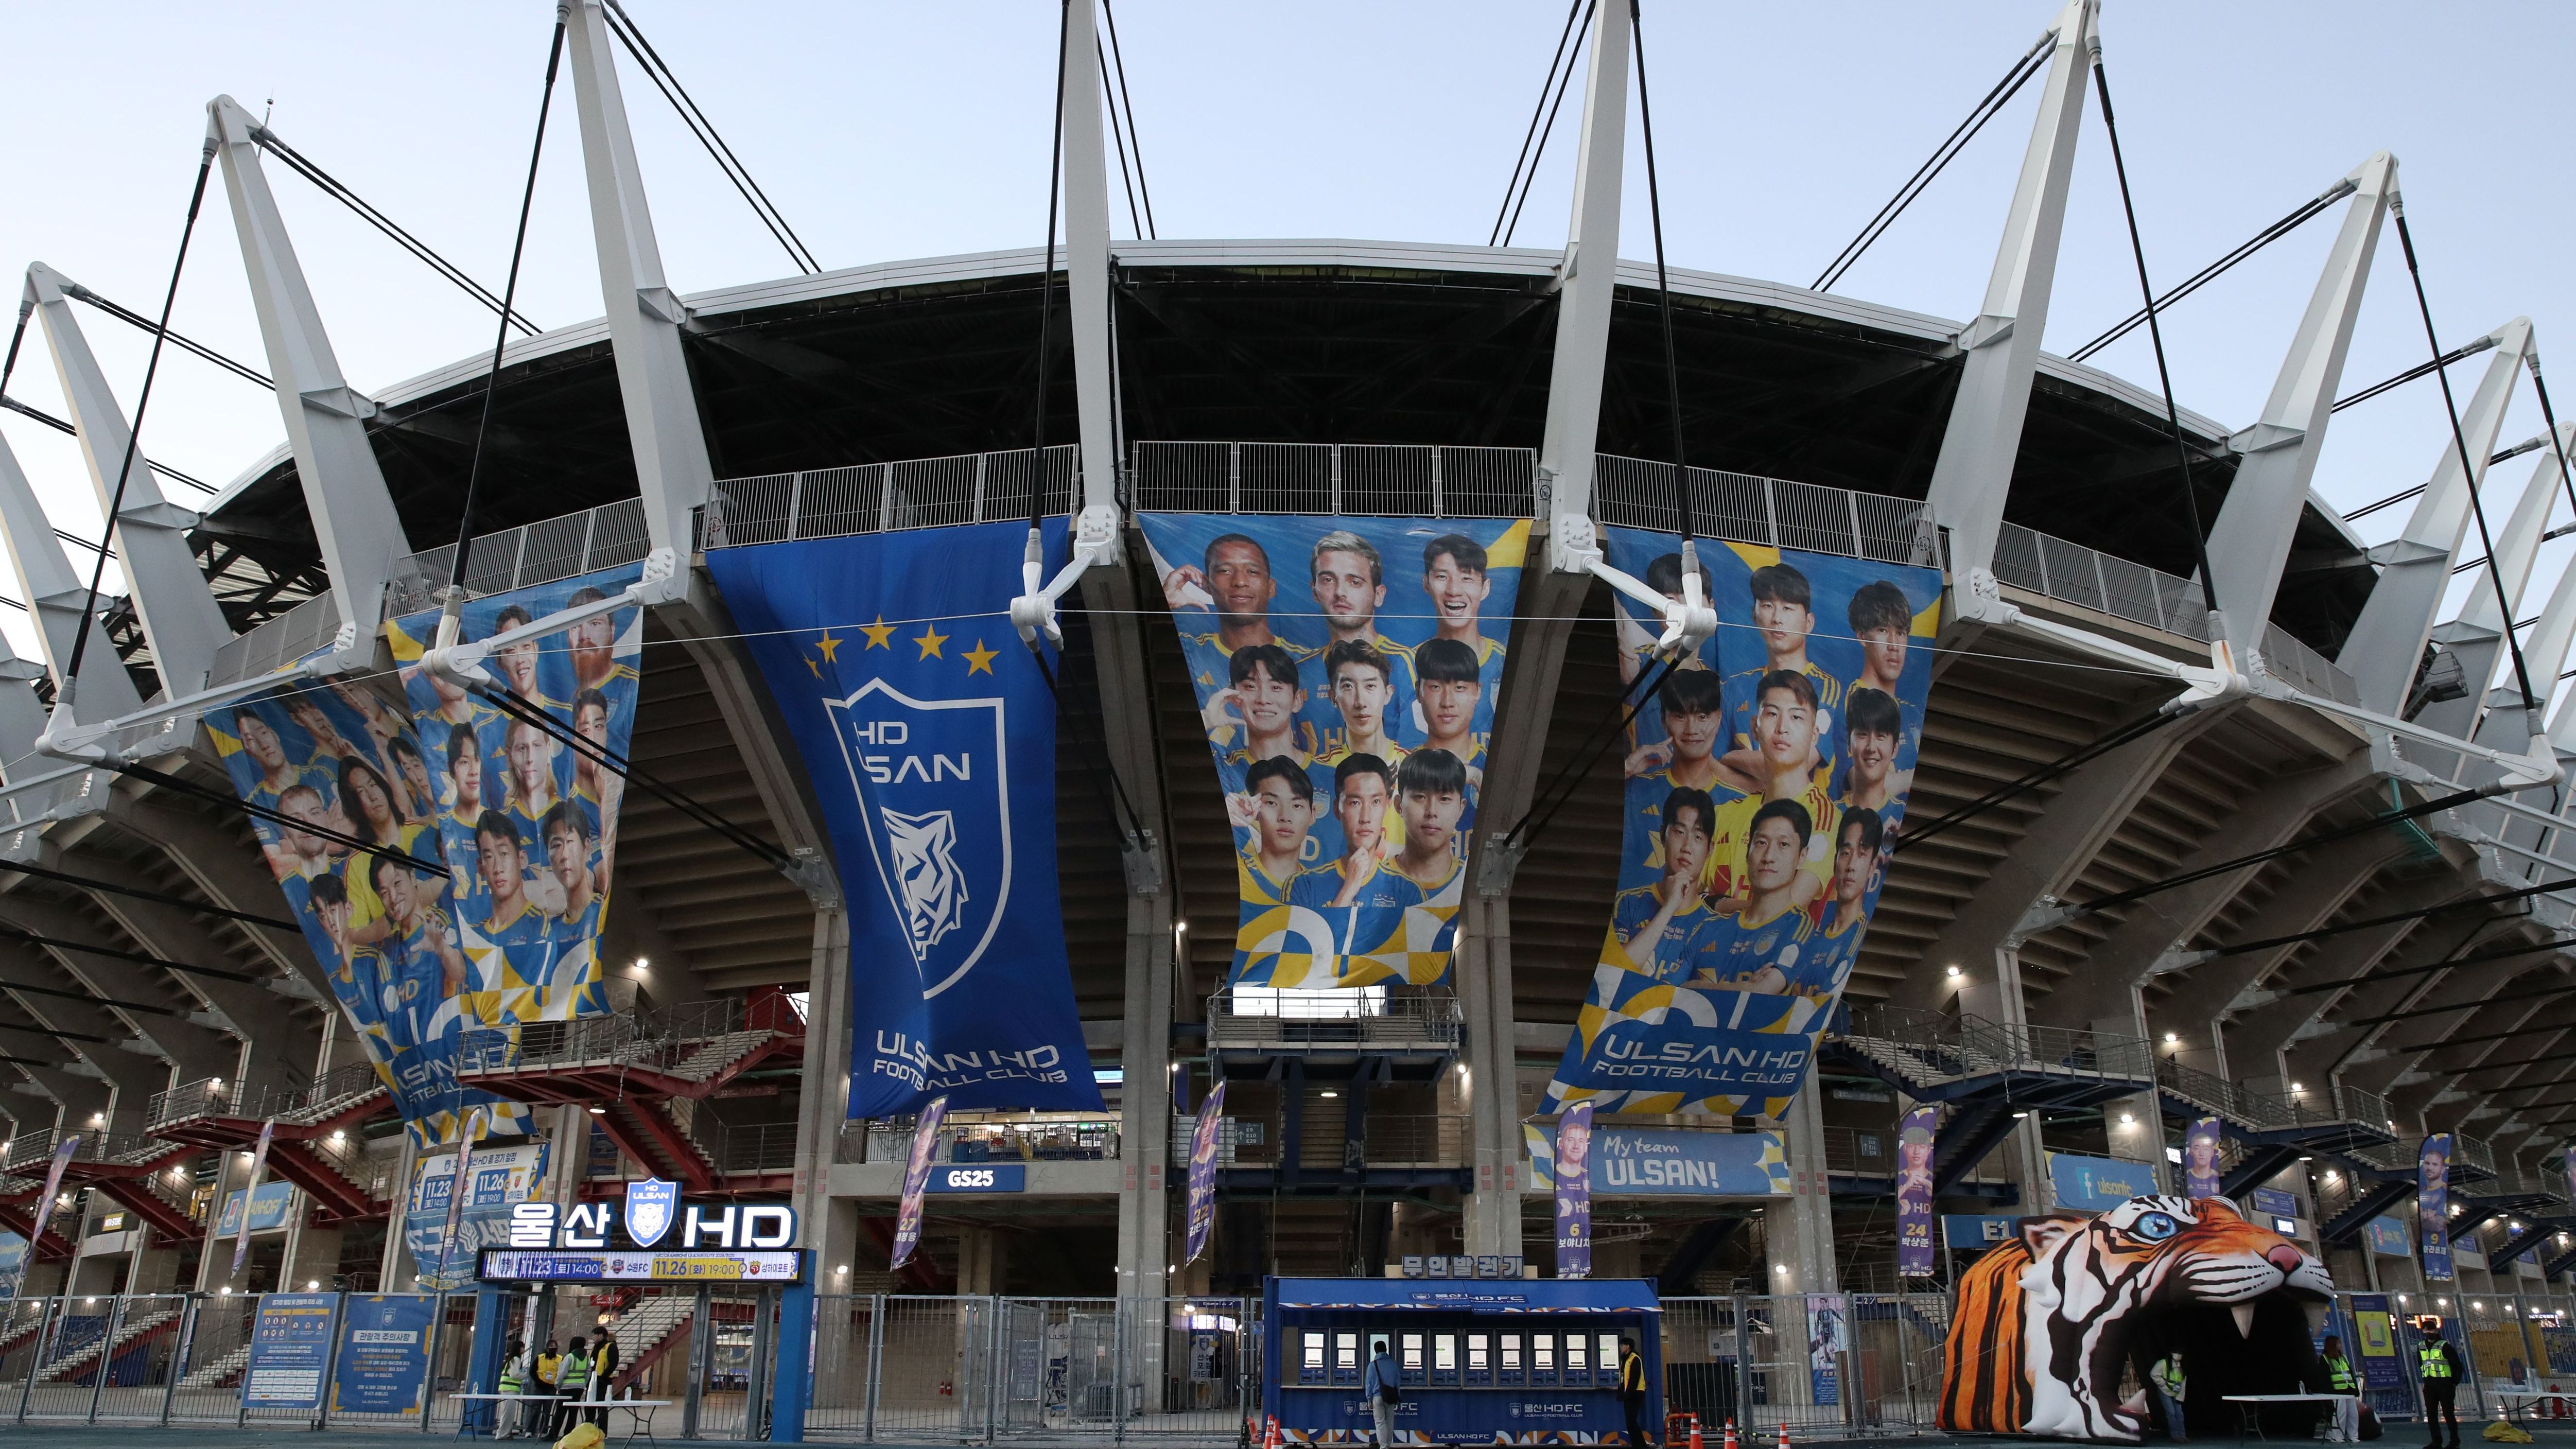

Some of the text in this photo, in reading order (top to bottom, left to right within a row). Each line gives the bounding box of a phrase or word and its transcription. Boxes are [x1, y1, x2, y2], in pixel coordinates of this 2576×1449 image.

[853, 721, 908, 744] HD
[1299, 835, 1320, 861] D
[877, 1029, 1059, 1073] ULSAN HD
[1604, 1034, 1805, 1069] ULSAN HD
[874, 1059, 1068, 1091] FOOTBALL CLUB
[1592, 1060, 1796, 1084] FOOTBALL CLUB
[1604, 1136, 1679, 1157] My team
[479, 1155, 488, 1164] HD
[494, 1154, 504, 1163] 경기
[947, 1170, 994, 1187] GS25
[1605, 1159, 1719, 1189] ULSAN!
[427, 1180, 452, 1198] 11.23
[480, 1173, 504, 1192] 11.26
[486, 1193, 501, 1203] 19:00
[1193, 1204, 1209, 1224] 22
[1575, 1200, 1590, 1213] HD
[1913, 1202, 1930, 1214] HD
[509, 1203, 611, 1248] 울산
[684, 1206, 792, 1248] HD
[900, 1217, 917, 1231] 27
[1570, 1223, 1580, 1236] 6
[1906, 1223, 1926, 1236] 24
[896, 1232, 917, 1242] 이청용
[2431, 1233, 2439, 1244] 9
[521, 1260, 551, 1275] 11.23
[572, 1263, 598, 1275] 14:00
[627, 1263, 648, 1272] 수원FC
[655, 1261, 735, 1276] 11.26 [화] 19:00
[761, 1263, 788, 1273] 상하이포트
[1402, 1255, 1524, 1278] 무인발권기
[360, 1332, 411, 1341] 관람객 주의사항
[1401, 1402, 1418, 1410] FC
[1524, 1404, 1542, 1412] 울산
[1544, 1404, 1563, 1412] HD
